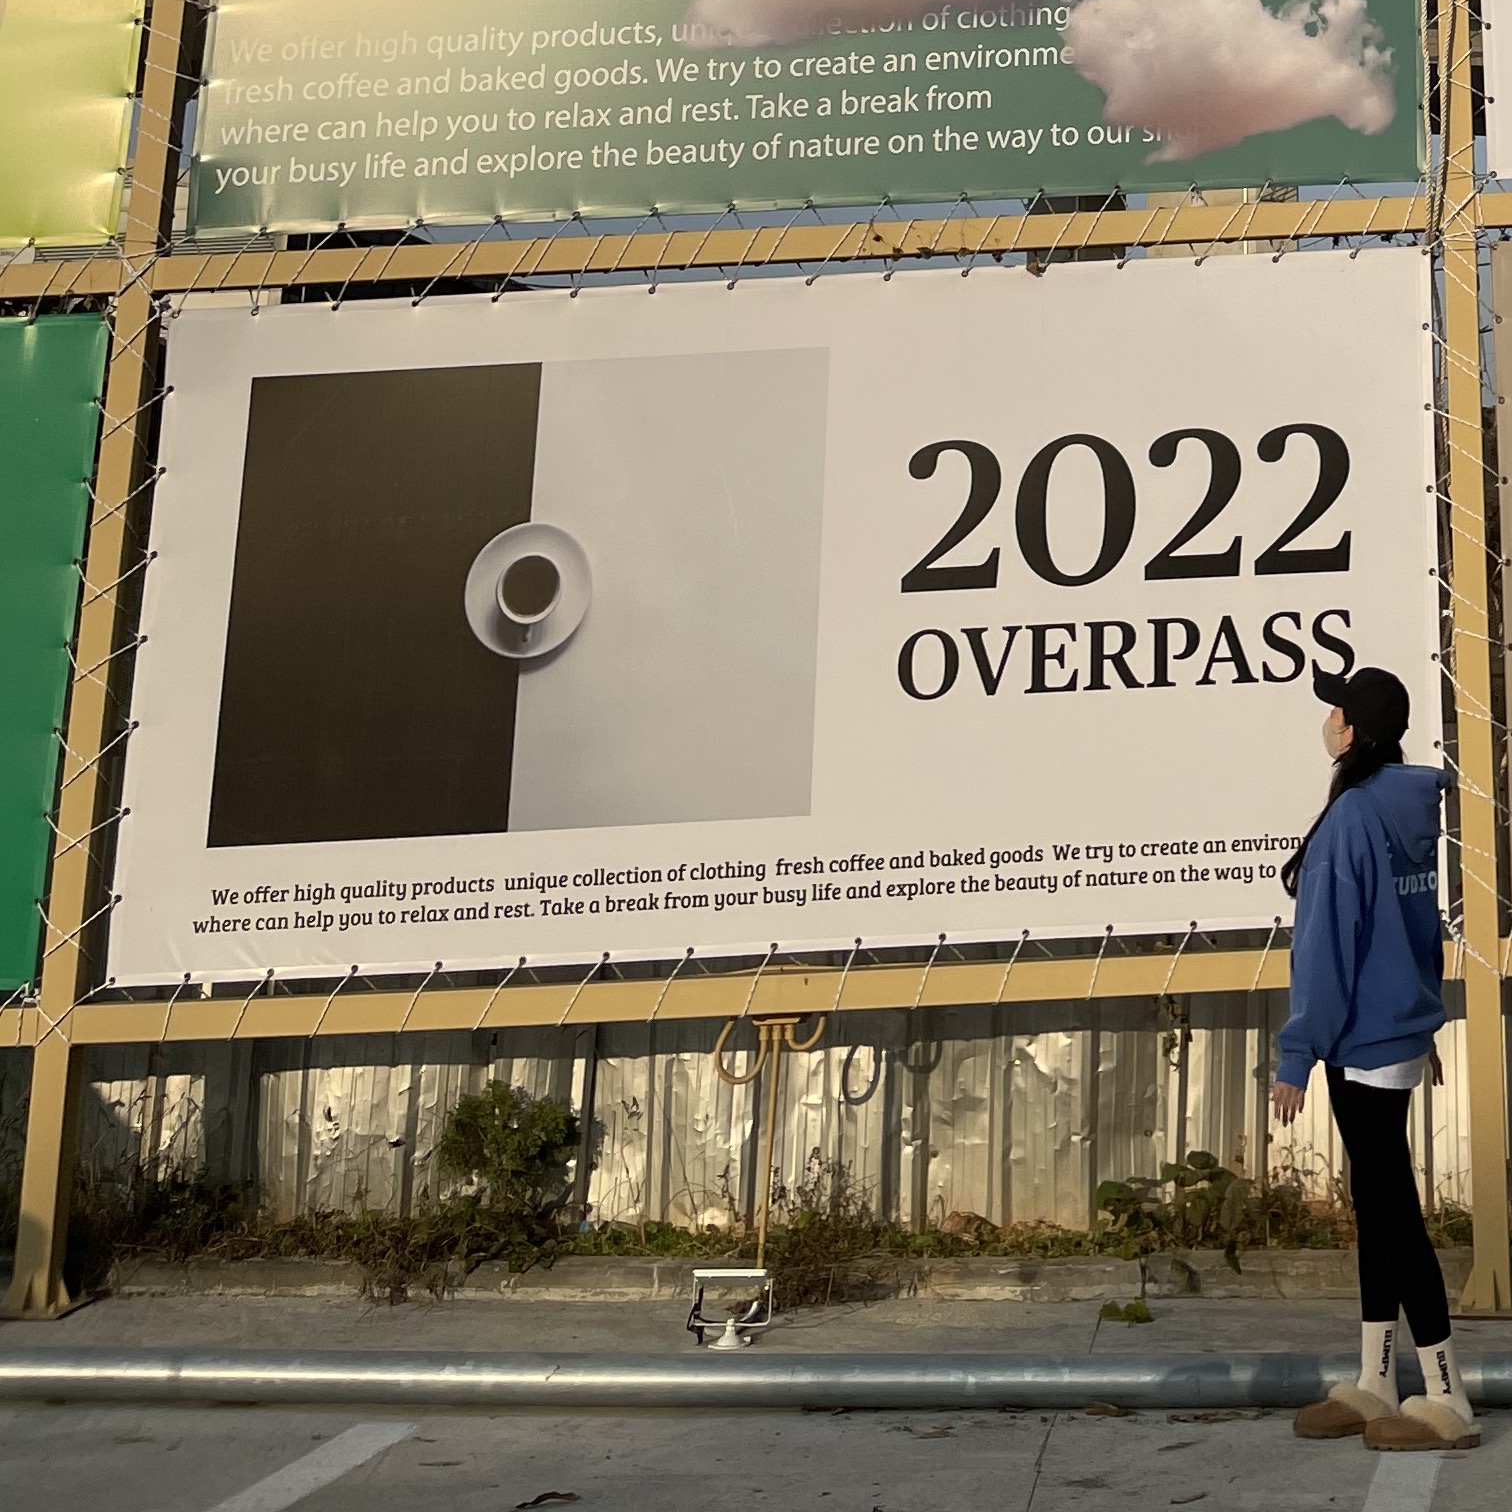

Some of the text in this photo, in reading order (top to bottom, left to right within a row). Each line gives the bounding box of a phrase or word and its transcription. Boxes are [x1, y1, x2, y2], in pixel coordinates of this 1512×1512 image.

[281, 35, 346, 61] offer
[355, 29, 418, 63] high
[427, 25, 525, 61] quality
[530, 20, 663, 56] products,
[956, 3, 1072, 31] clothing
[302, 51, 876, 101] coffee and baked goods. We try create
[220, 84, 992, 146] where can help you relax and rest. Take break from
[214, 164, 282, 194] your
[288, 156, 357, 188] busy
[364, 150, 407, 179] life
[413, 147, 469, 177] and
[476, 144, 584, 179] explore
[590, 140, 638, 168] the
[646, 138, 746, 169] beauty
[788, 133, 881, 159] nature
[931, 124, 979, 152] the
[986, 128, 1044, 155] way
[1086, 125, 1135, 145] our
[901, 423, 1352, 593] 2022
[898, 609, 1356, 701] OVERPASS
[192, 863, 1254, 934] where can help you relax and rest. Take break from your busy life and explore the beauty nature the way
[210, 839, 1199, 906] We offer high quality products unique collection clothing fresh coffee and baked goods We try create
